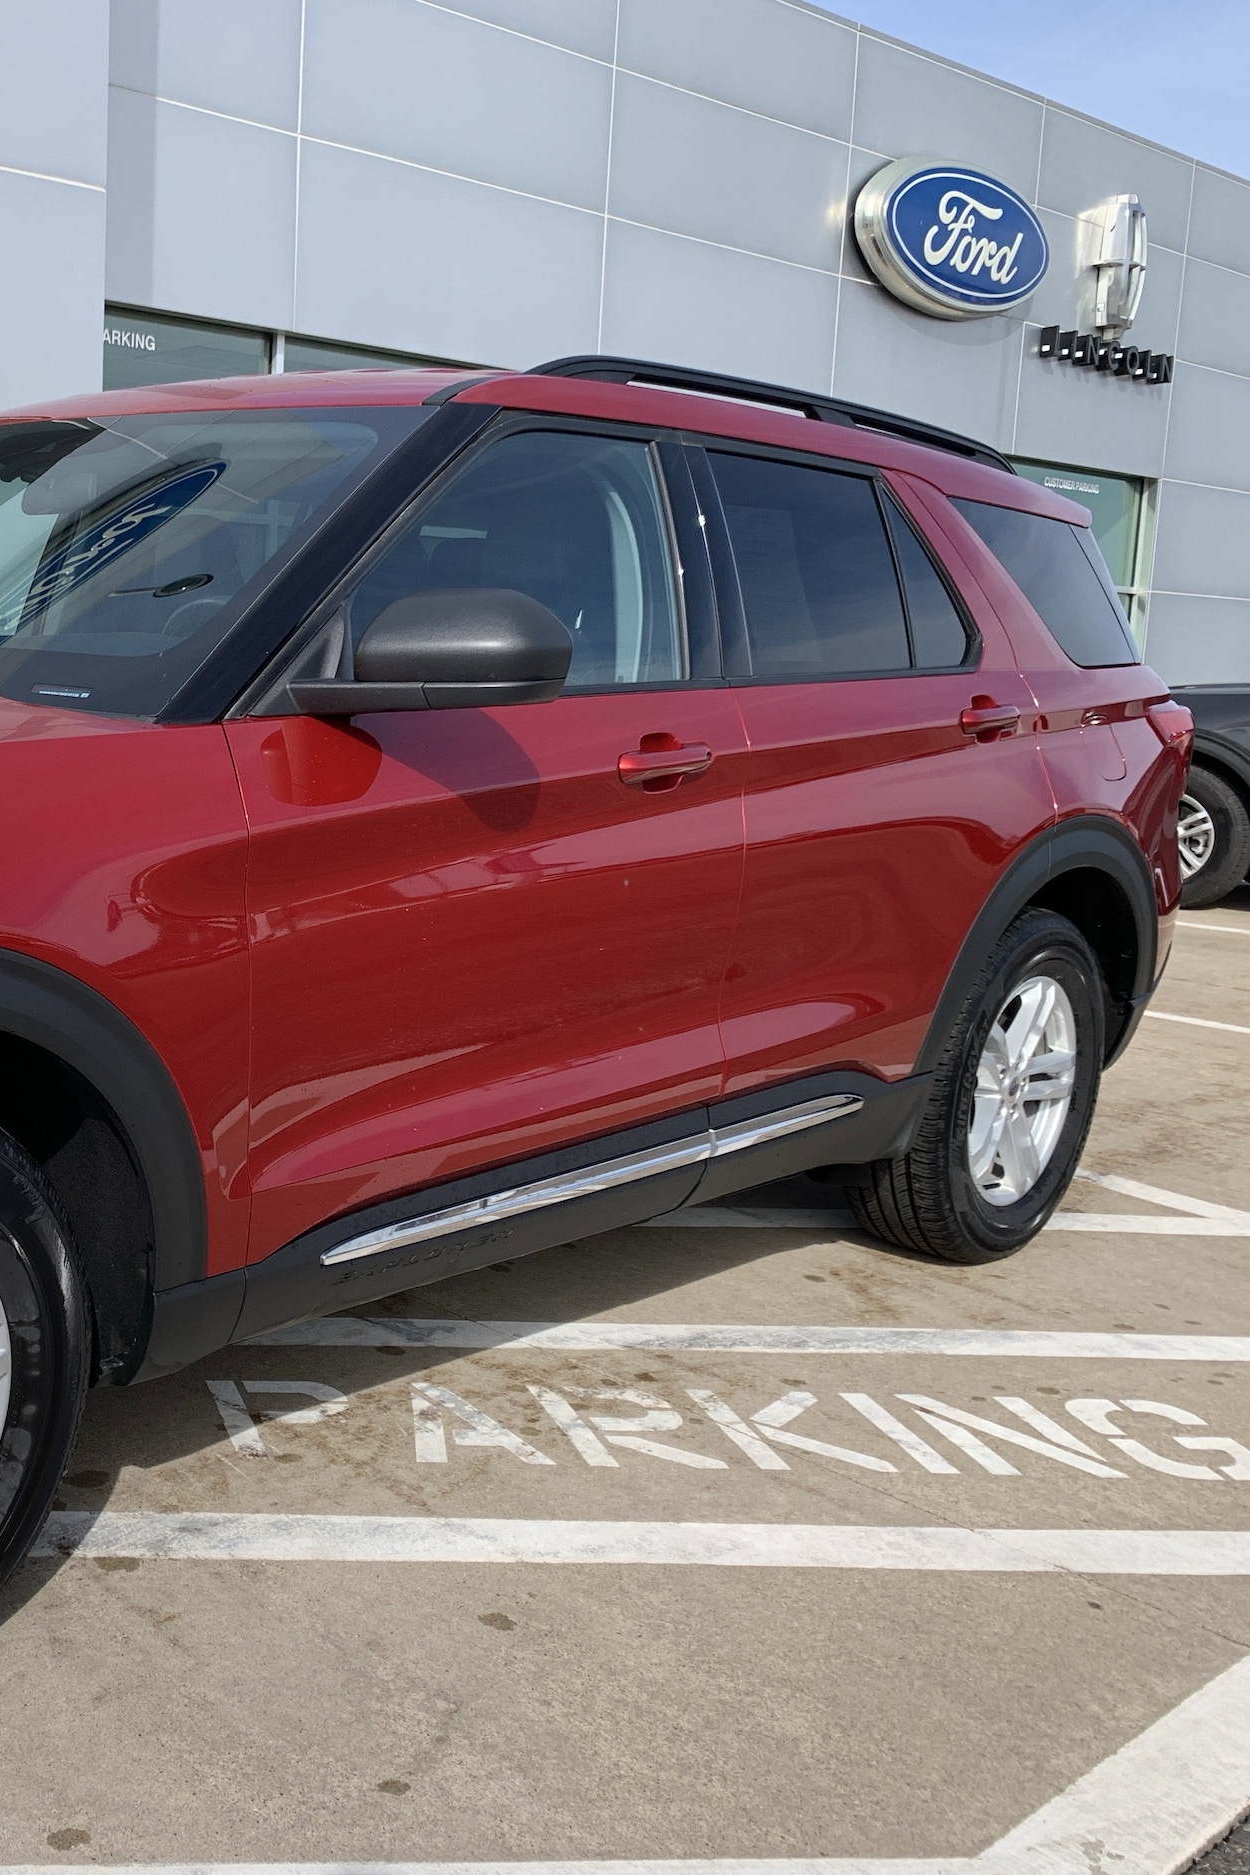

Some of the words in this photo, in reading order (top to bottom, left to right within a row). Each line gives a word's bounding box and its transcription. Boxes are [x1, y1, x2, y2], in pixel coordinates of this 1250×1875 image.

[924, 190, 1024, 285] Ford
[103, 328, 156, 351] ARKING
[1040, 325, 1174, 384] LINCOLN
[1044, 476, 1076, 490] CUSTOMER
[1076, 481, 1100, 494] PARKING
[204, 1379, 1250, 1482] PARKING
